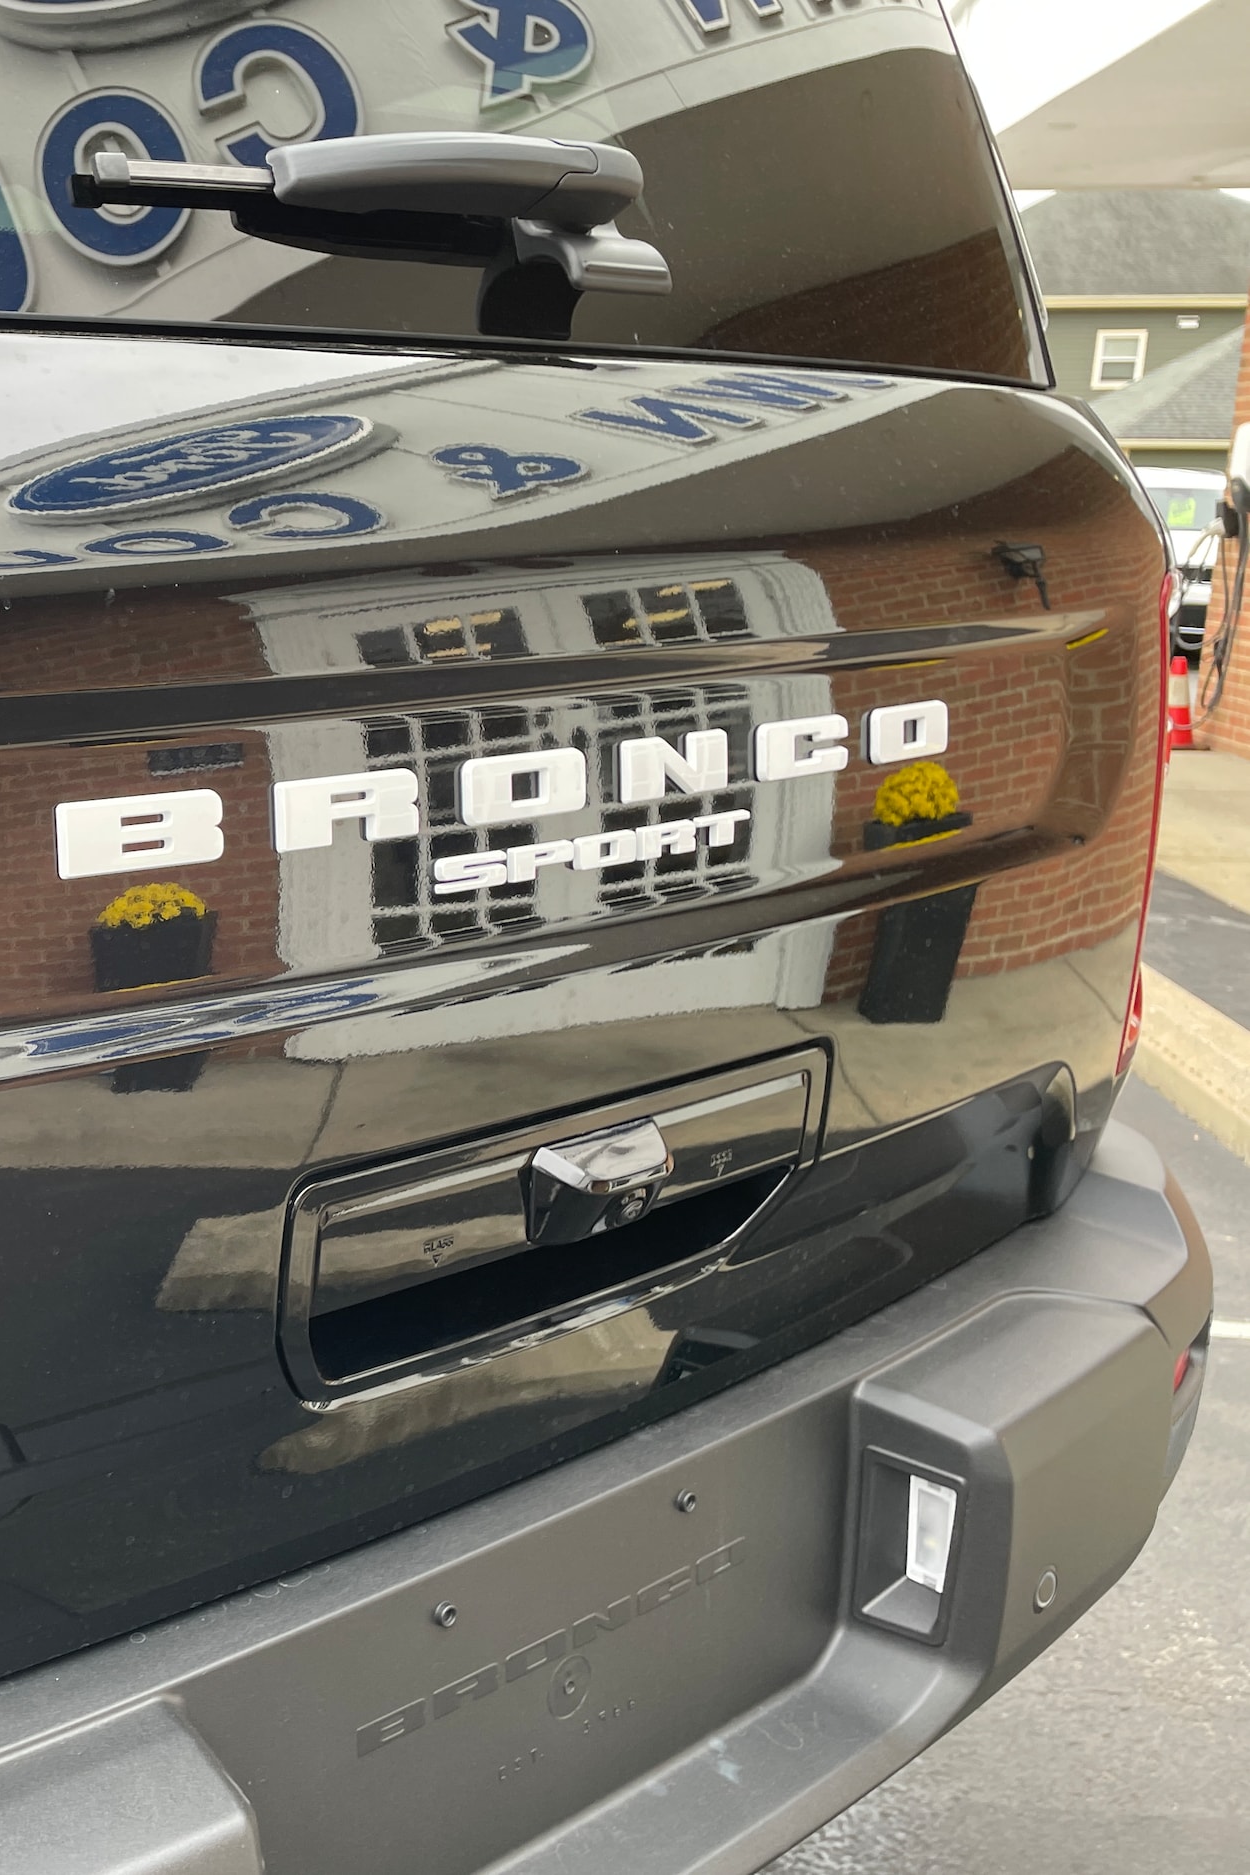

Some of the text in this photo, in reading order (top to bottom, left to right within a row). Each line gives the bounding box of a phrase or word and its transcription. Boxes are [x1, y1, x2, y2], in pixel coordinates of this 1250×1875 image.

[55, 698, 949, 880] BRONCO
[434, 808, 751, 895] SPORT
[356, 1536, 746, 1758] BRONCO
